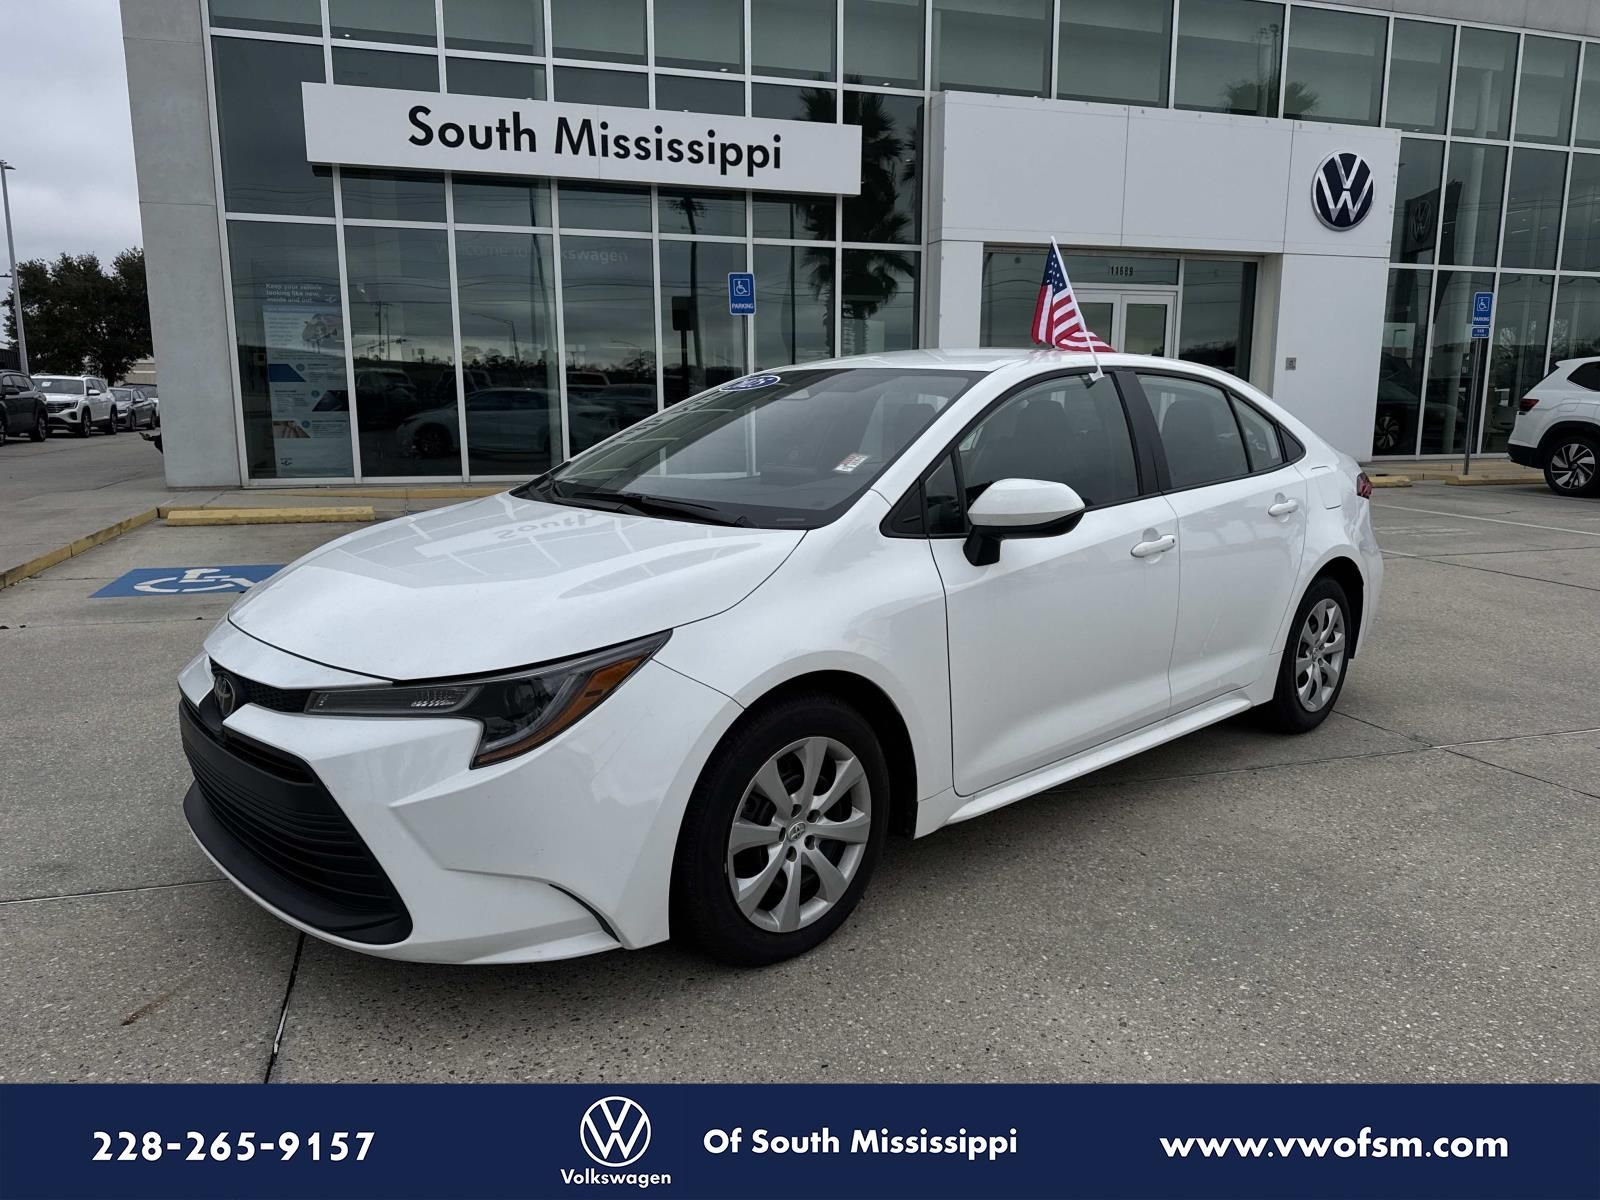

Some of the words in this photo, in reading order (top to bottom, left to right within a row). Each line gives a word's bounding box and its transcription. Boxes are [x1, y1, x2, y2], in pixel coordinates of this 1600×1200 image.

[408, 105, 537, 152] South
[554, 116, 782, 177] Mississippi
[1314, 152, 1374, 227] VW
